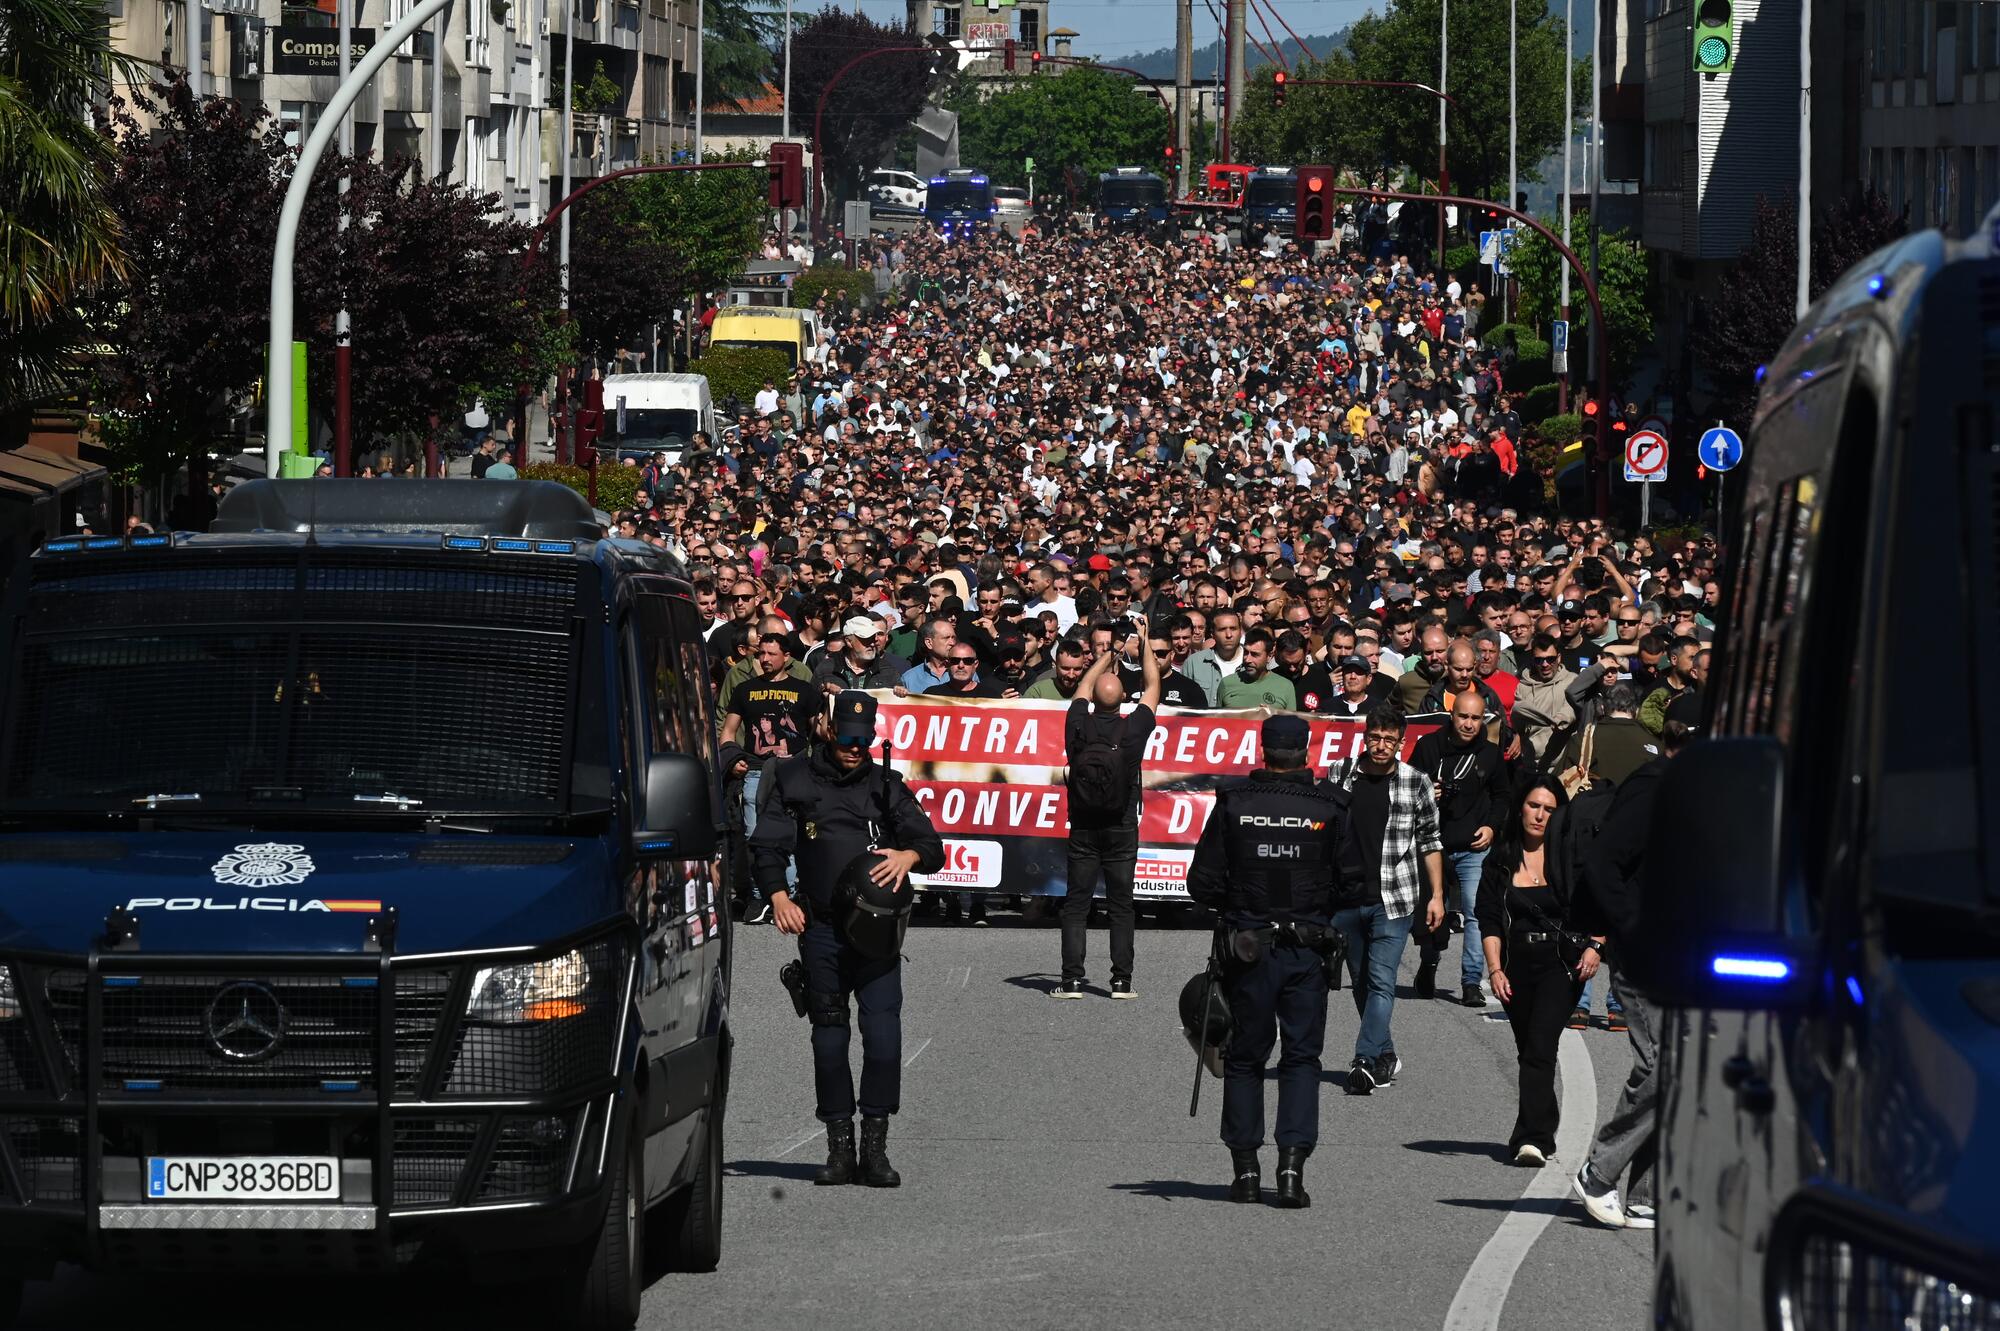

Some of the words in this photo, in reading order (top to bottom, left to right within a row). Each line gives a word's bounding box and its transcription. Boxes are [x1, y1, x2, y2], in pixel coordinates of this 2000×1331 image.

[1555, 324, 1564, 346] P
[749, 690, 769, 701] PULP
[769, 689, 799, 702] FICTION
[1240, 815, 1313, 829] POLICIA
[1135, 862, 1184, 877] CCOO
[928, 873, 978, 882] INDUSTRIA
[1133, 880, 1186, 892] ndustria
[126, 898, 331, 912] POLICIA
[154, 1181, 161, 1190] E
[167, 1162, 332, 1192] CNP3836BD
